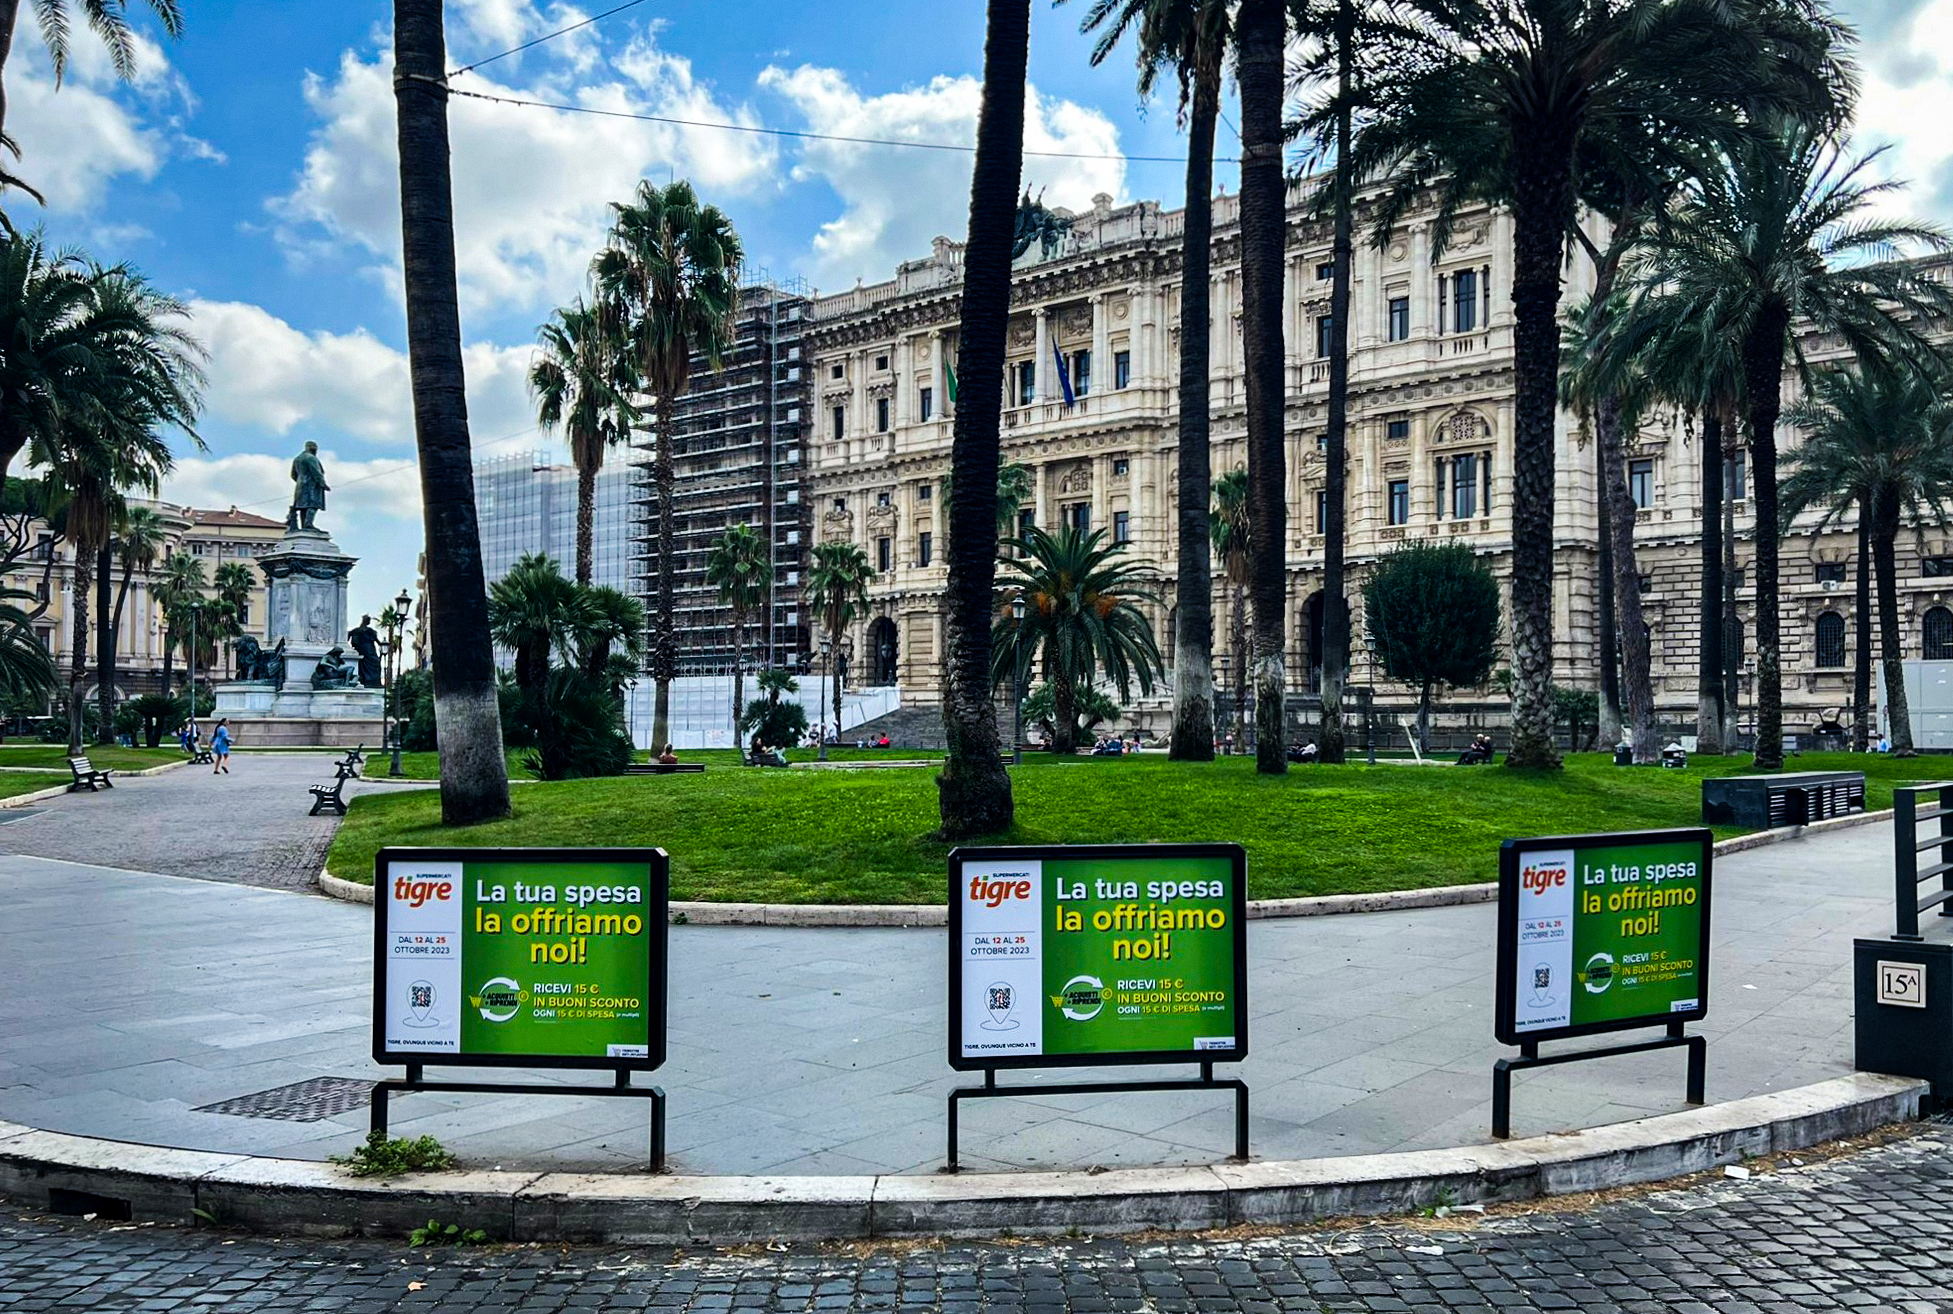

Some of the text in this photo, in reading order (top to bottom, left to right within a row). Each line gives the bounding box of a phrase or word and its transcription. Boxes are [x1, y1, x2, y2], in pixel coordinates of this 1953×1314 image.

[1584, 861, 1697, 884] La tua spesa
[1523, 865, 1566, 895] tigre
[395, 875, 452, 907] tigre
[476, 879, 642, 908] La tua spesa
[970, 875, 1031, 907] tigre
[1056, 877, 1224, 903] La tua spesa
[1583, 885, 1697, 913] la offriamo
[476, 907, 642, 935] la offriamo
[1056, 904, 1226, 931] la offriamo
[1621, 911, 1660, 937] noi!
[398, 936, 446, 944] DAL 12 AL 25
[974, 937, 990, 945] DAL
[1015, 936, 1025, 944] 25
[1522, 931, 1549, 940] OTTOBRE
[395, 946, 450, 954] OTTOBRE 2023
[531, 937, 587, 963] noi!
[970, 947, 1030, 955] OTTOBRE 2023
[1113, 932, 1171, 960] noi!
[1622, 953, 1649, 964] RICEVI
[1651, 951, 1659, 960] 15
[1622, 967, 1631, 975] IN
[1633, 964, 1659, 974] BUONI
[1660, 960, 1693, 971] SCONTO
[1117, 979, 1184, 990] RICEVI 15 €
[1622, 977, 1637, 985] OGNI
[533, 983, 600, 994] RICEVI 15 €
[533, 997, 640, 1008] IN BUONI SCONTO
[1117, 991, 1225, 1003] IN BUONI SCONTO
[533, 1009, 555, 1017] OGNI
[558, 1010, 566, 1018] 15
[576, 1010, 585, 1018] DI
[587, 1010, 615, 1018] SPESA
[1117, 1006, 1140, 1014] OGNI
[1162, 1005, 1171, 1013] DI
